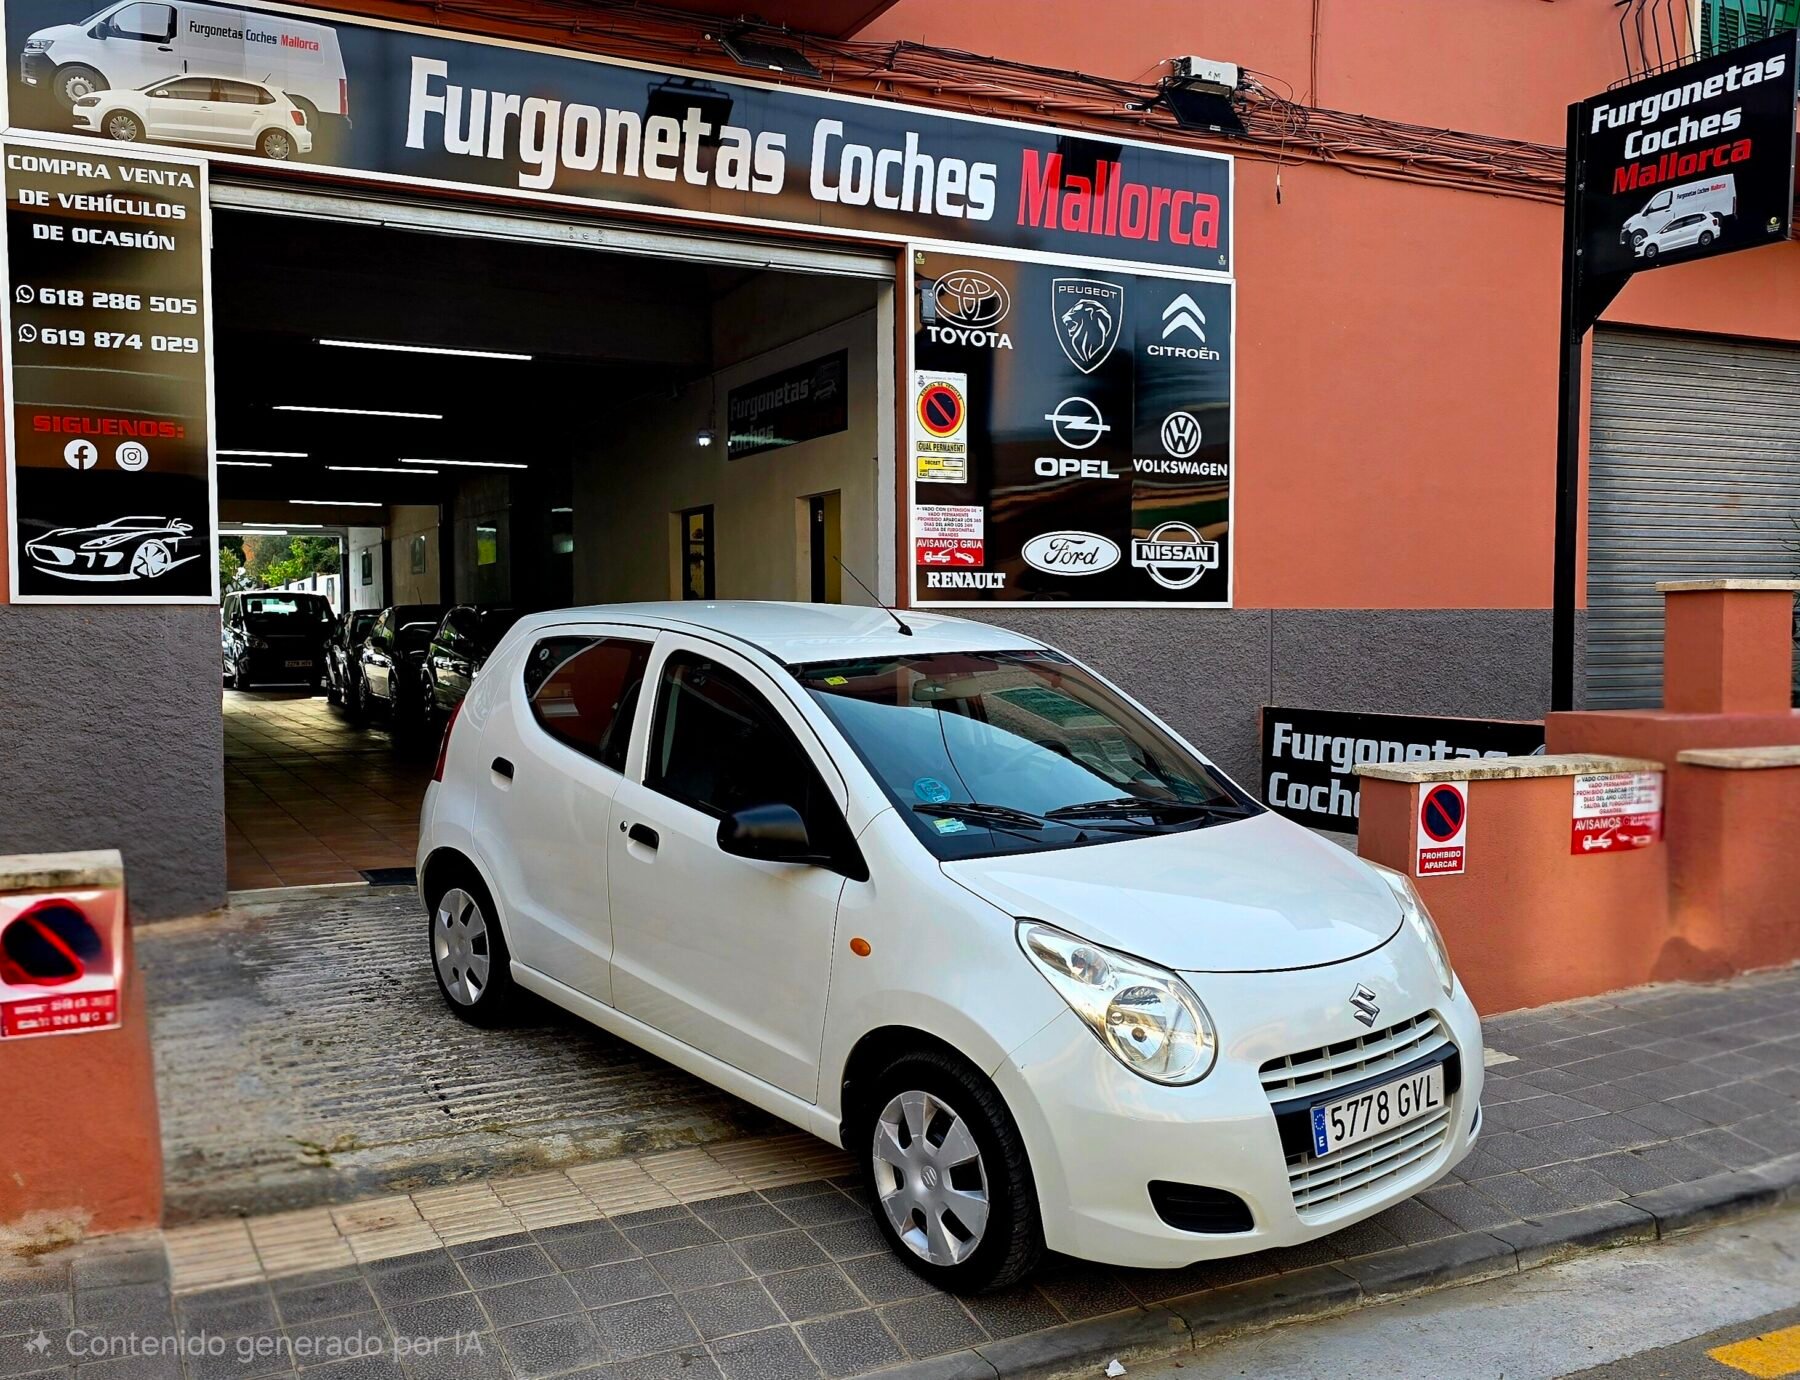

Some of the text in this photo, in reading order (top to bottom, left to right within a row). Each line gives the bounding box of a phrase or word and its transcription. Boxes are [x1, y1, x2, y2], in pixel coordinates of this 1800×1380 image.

[189, 20, 319, 51] Furgonetas Coches Mallorca
[1591, 54, 1786, 134] Furgonetas
[1624, 107, 1742, 159] Coches
[405, 56, 1222, 249] Furgonetas Coches Mallorca
[8, 154, 195, 188] COMPRA VENTA
[1612, 138, 1753, 195] Mallorca
[19, 189, 186, 220] DE VEHÍCULOS
[33, 224, 175, 251] DE OCASIÓN
[39, 288, 197, 314] 618 286 505
[1058, 285, 1118, 299] PEUGEOT
[41, 328, 199, 353] 619 874 029
[927, 326, 1013, 349] TOYOTA
[730, 378, 809, 421] Furgonetas
[33, 415, 185, 438] SIGUENOS:
[933, 443, 964, 453] PERMANENT
[1034, 457, 1119, 479] OPEL
[1133, 459, 1228, 476] VOLKSWAGEN
[917, 539, 983, 549] AVISAMOS GRUA
[1044, 538, 1099, 565] Ford
[1142, 545, 1208, 561] NISSAN
[926, 572, 1006, 589] RENAULT
[1272, 722, 1508, 774] Furgonet
[1268, 772, 1360, 818] Coch
[1575, 817, 1621, 831] AVISAMOS
[1422, 850, 1461, 859] PROHIBIDO
[1424, 860, 1457, 869] APARCAR
[1331, 1075, 1438, 1141] 5778 GVL
[1318, 1135, 1325, 1147] E
